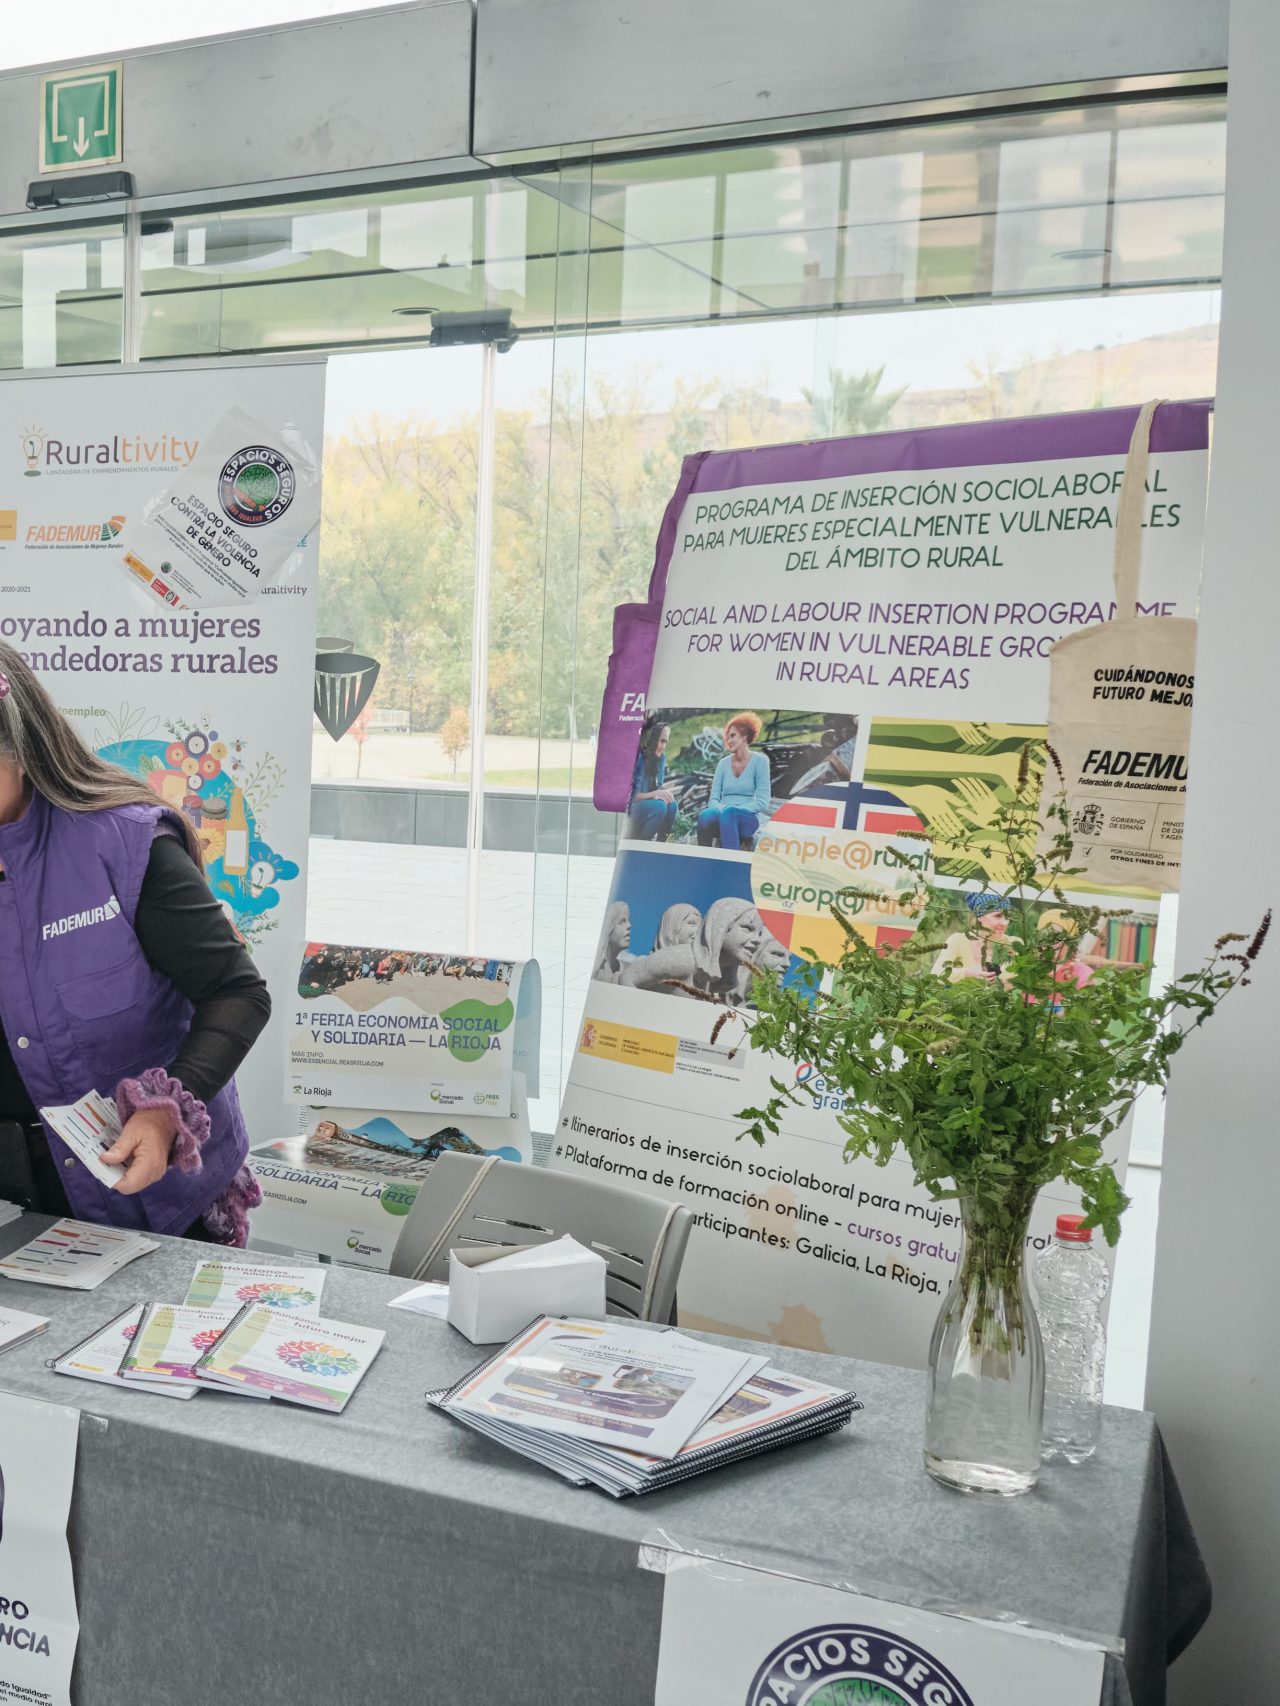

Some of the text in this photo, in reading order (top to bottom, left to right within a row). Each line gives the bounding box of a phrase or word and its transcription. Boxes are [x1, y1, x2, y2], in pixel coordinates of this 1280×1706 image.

[46, 435, 199, 467] Ruraltivity
[223, 450, 277, 483] ESPACIOS
[264, 463, 291, 520] SEGUROS
[695, 495, 805, 524] PROGRAMA
[811, 492, 838, 513] DE
[841, 480, 957, 509] INSERCIÓN
[25, 525, 102, 541] FADEMUR
[171, 496, 206, 531] CONTRA
[205, 526, 216, 540] LA
[215, 536, 261, 578] VIOLENCIA
[186, 525, 197, 540] DE
[187, 494, 224, 530] ESPACIO
[223, 525, 258, 558] SEGURO
[683, 503, 1182, 552] PARA MUJERES ESPECIALMENTE VULNERAES
[785, 545, 1003, 571] DEL ÁMBITO RURAL
[114, 614, 131, 637] a
[138, 611, 261, 643] mujeres
[664, 606, 717, 628] SOCIAL
[723, 604, 767, 624] AND
[771, 601, 862, 623] LABOUR
[868, 602, 989, 625] INSERTION
[687, 632, 1064, 658] FOR WOMEN IN VULNERABLE GRO
[171, 646, 279, 674] rurales
[776, 661, 970, 689] IN RURAL AREAS
[1094, 665, 1195, 689] CUIDÁNDONOS
[1093, 686, 1193, 707] FUTURO MEJO
[1082, 750, 1188, 780] FADEMU
[1114, 780, 1123, 788] de
[1124, 781, 1177, 792] Asociaciones
[1111, 816, 1146, 825] GOBIERNO
[1110, 855, 1134, 863] OTROS
[42, 905, 105, 940] FADEMUR
[295, 1012, 503, 1033] 1ª FERIA ECONOMÍA SOCIAL
[311, 1030, 501, 1050] Y SOLIDARIA LA RIOJA
[303, 1087, 332, 1097] La Rioja
[255, 1166, 339, 1190] SOLIDARIA
[361, 1187, 381, 1199] LA
[569, 1115, 961, 1230] Itinerarios de inserción sociolaboral para mujer
[564, 1144, 961, 1265] Plataforma de formación online cursos gratui
[796, 1237, 860, 1272] Galicia,
[865, 1256, 887, 1277] La
[891, 1264, 941, 1298] Rioja,
